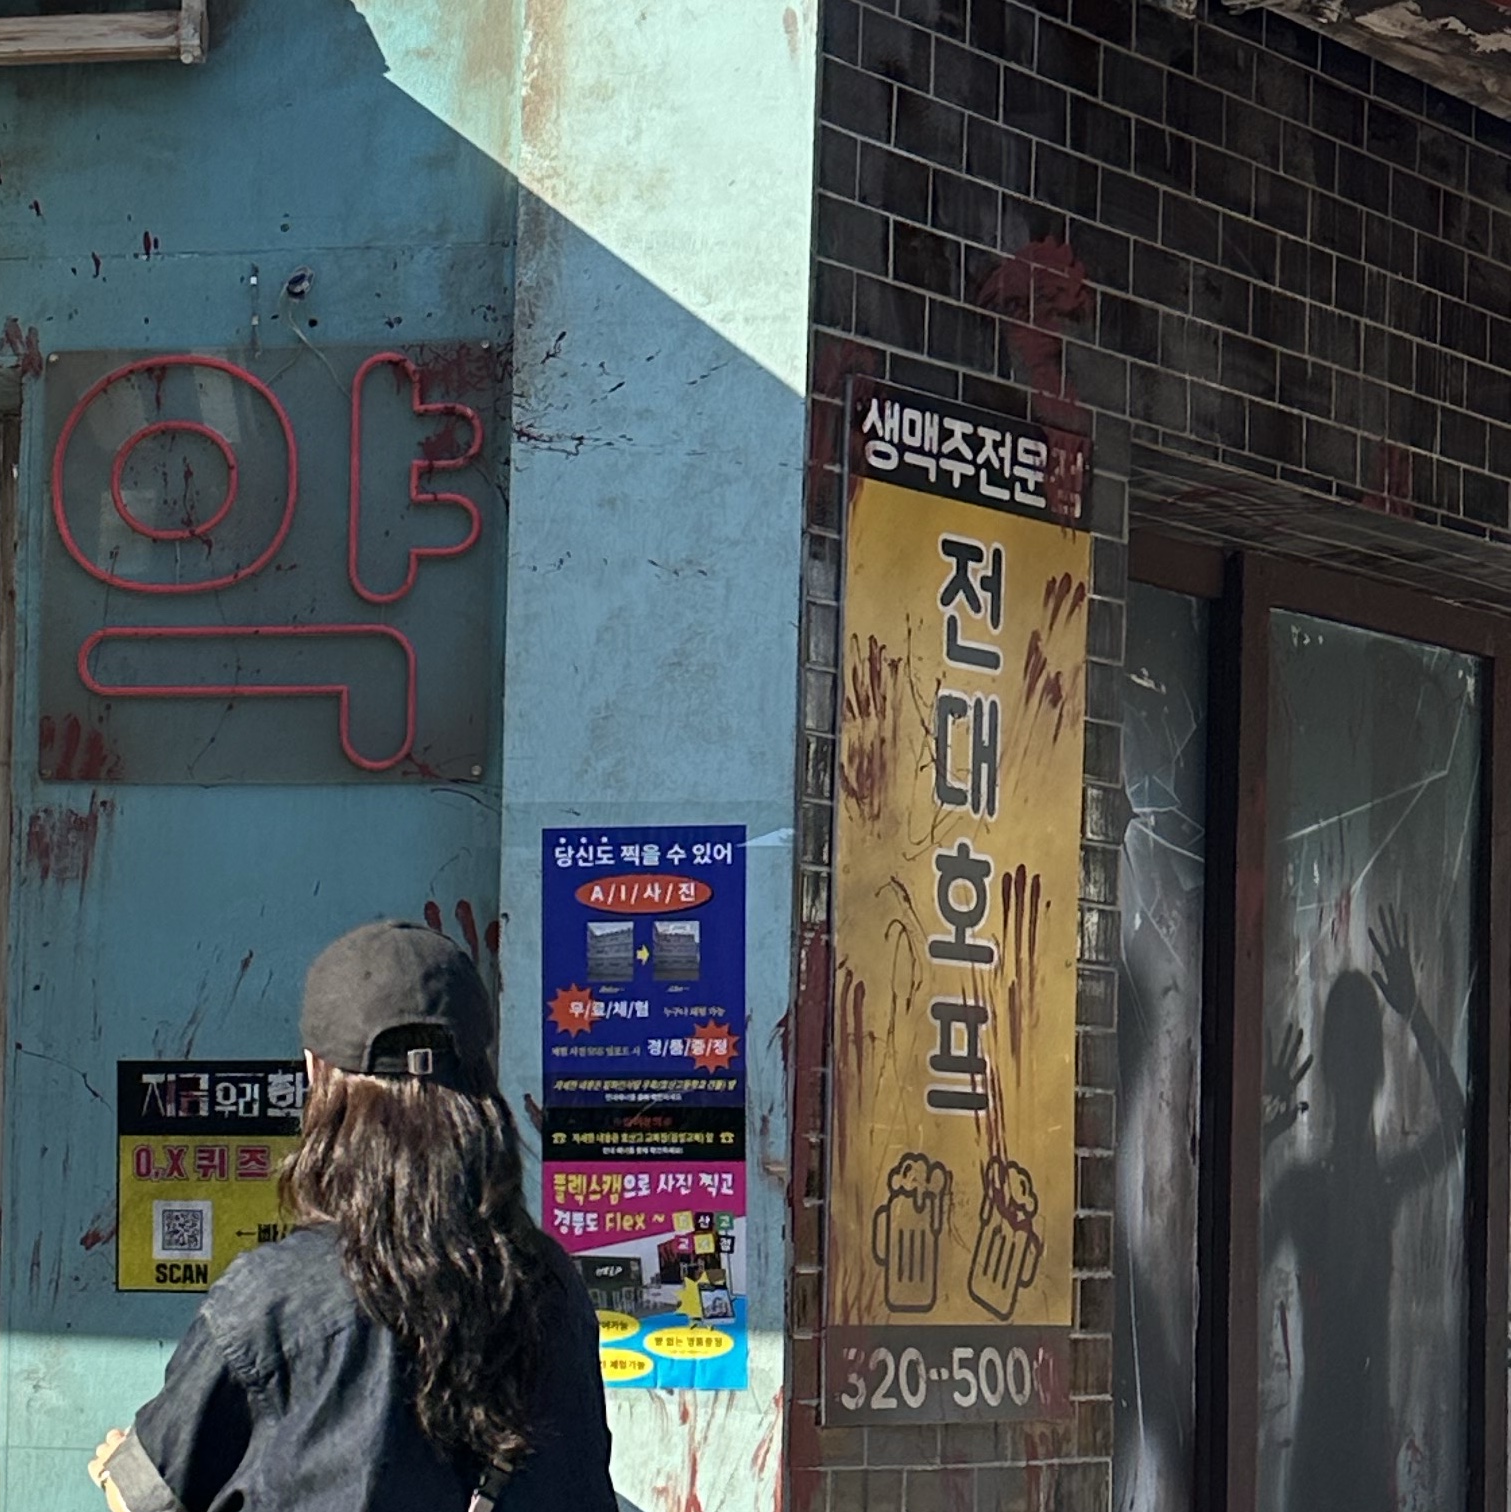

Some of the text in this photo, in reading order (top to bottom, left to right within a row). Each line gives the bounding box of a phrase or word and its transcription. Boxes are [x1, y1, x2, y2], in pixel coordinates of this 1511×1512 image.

[52, 351, 483, 771] 약
[554, 843, 733, 868] 당신도 찍을 수 있어
[657, 1173, 693, 1195] 사진
[699, 1173, 734, 1197] 찍고
[553, 1208, 599, 1235] 경품도
[155, 1263, 208, 1284] SCAN
